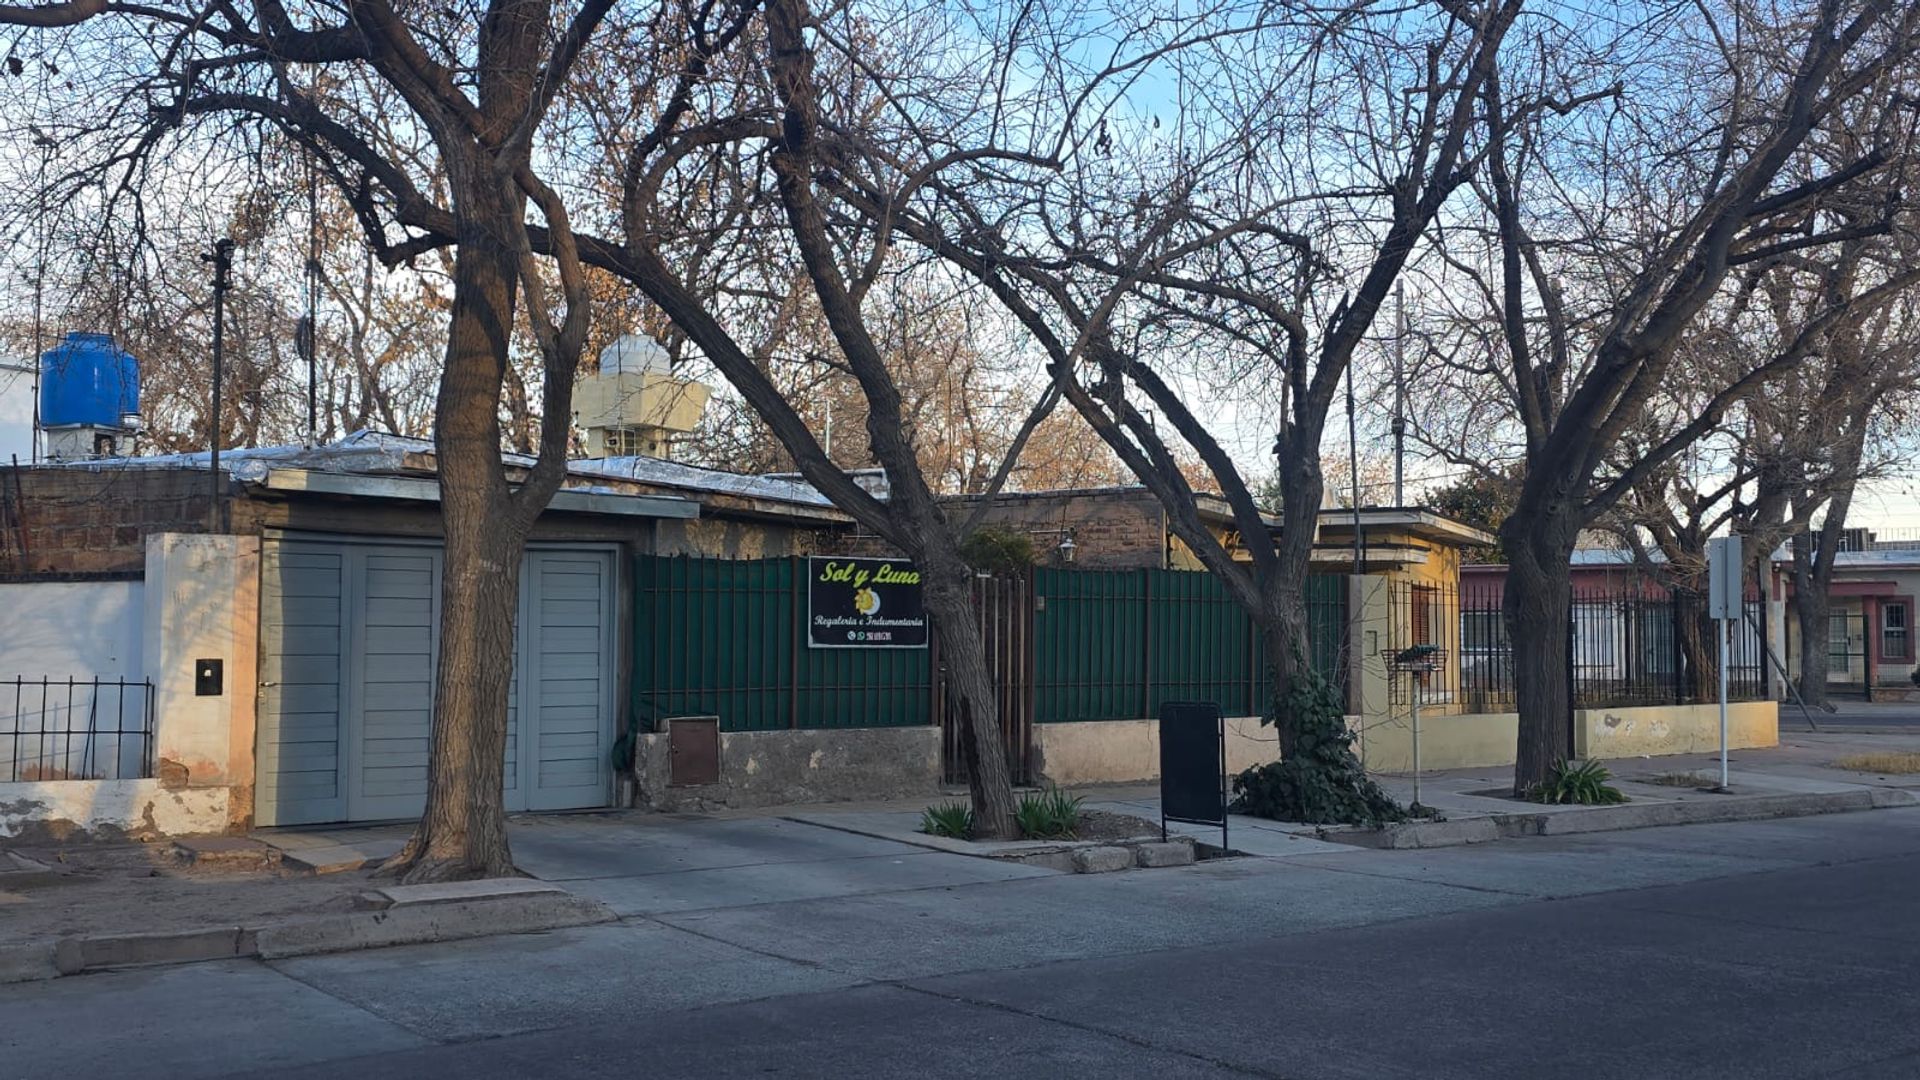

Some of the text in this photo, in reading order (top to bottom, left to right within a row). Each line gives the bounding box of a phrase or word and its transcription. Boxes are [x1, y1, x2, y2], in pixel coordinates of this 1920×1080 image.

[820, 561, 920, 588] Sol y Luna
[865, 615, 923, 627] Indumentaria
